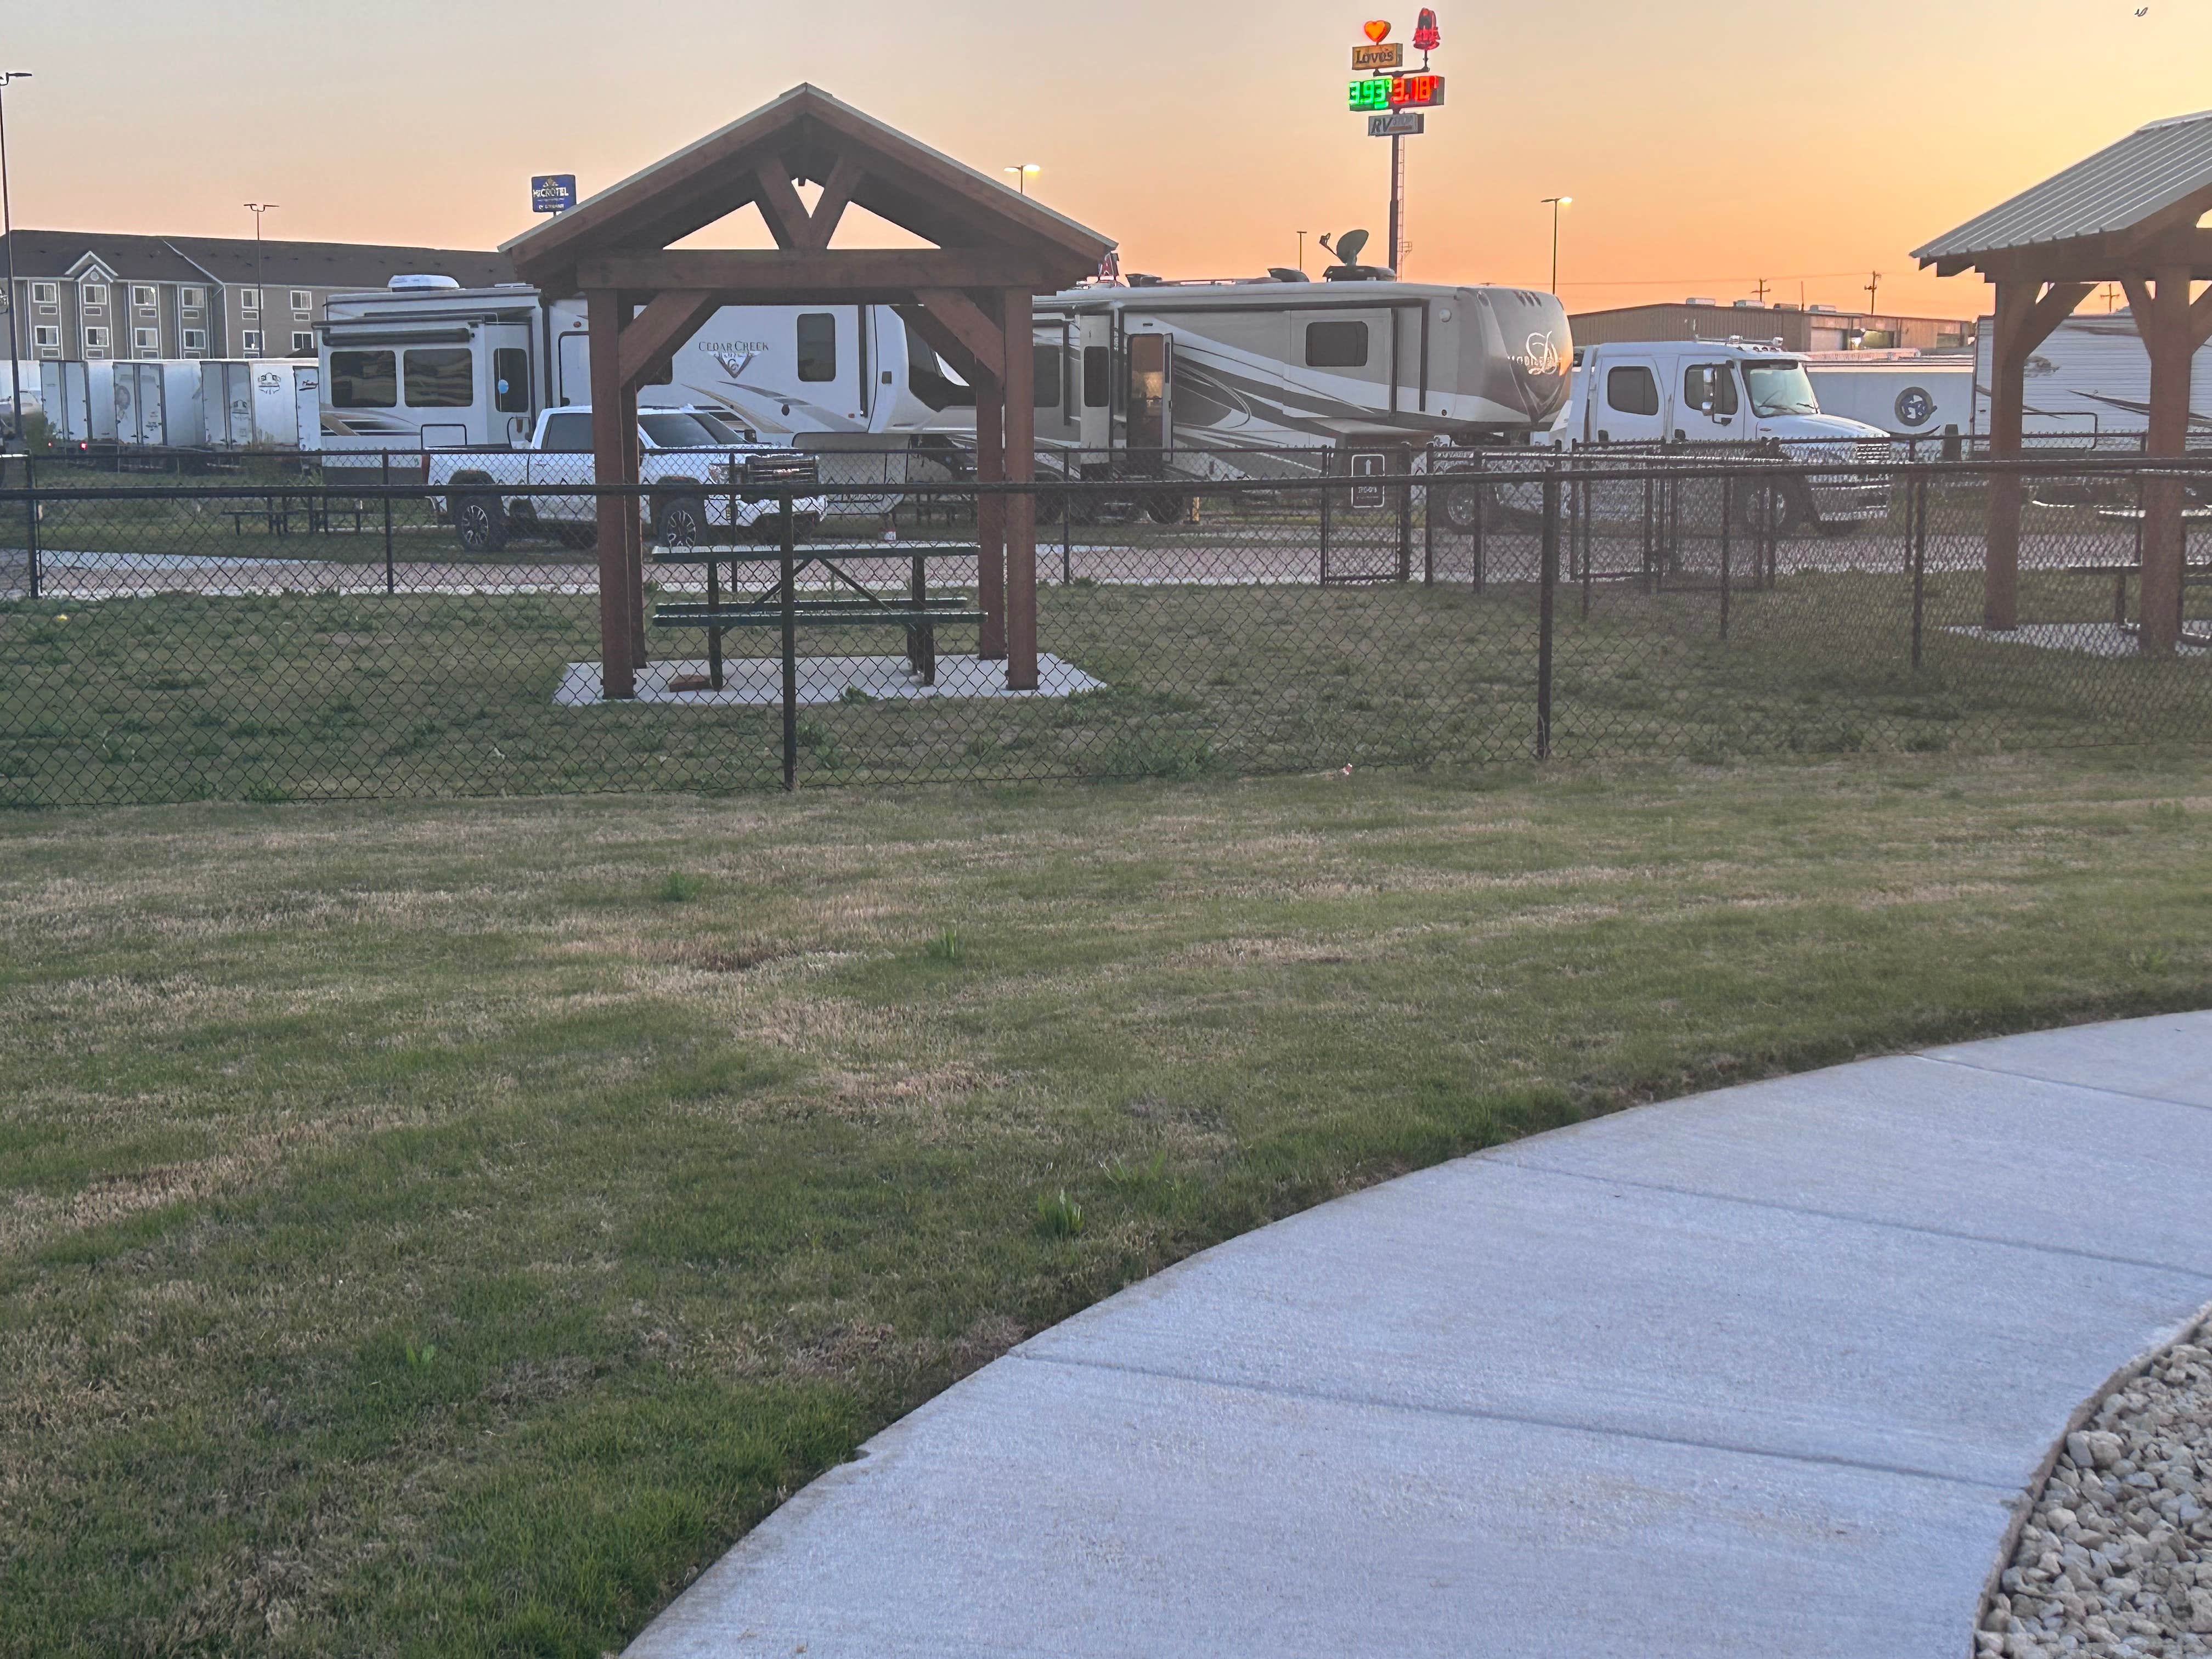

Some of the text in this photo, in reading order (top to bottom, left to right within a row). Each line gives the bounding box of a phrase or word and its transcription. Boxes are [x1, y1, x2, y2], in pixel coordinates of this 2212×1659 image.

[1370, 116, 1393, 133] RV
[698, 341, 769, 352] CEDAR CREEK
